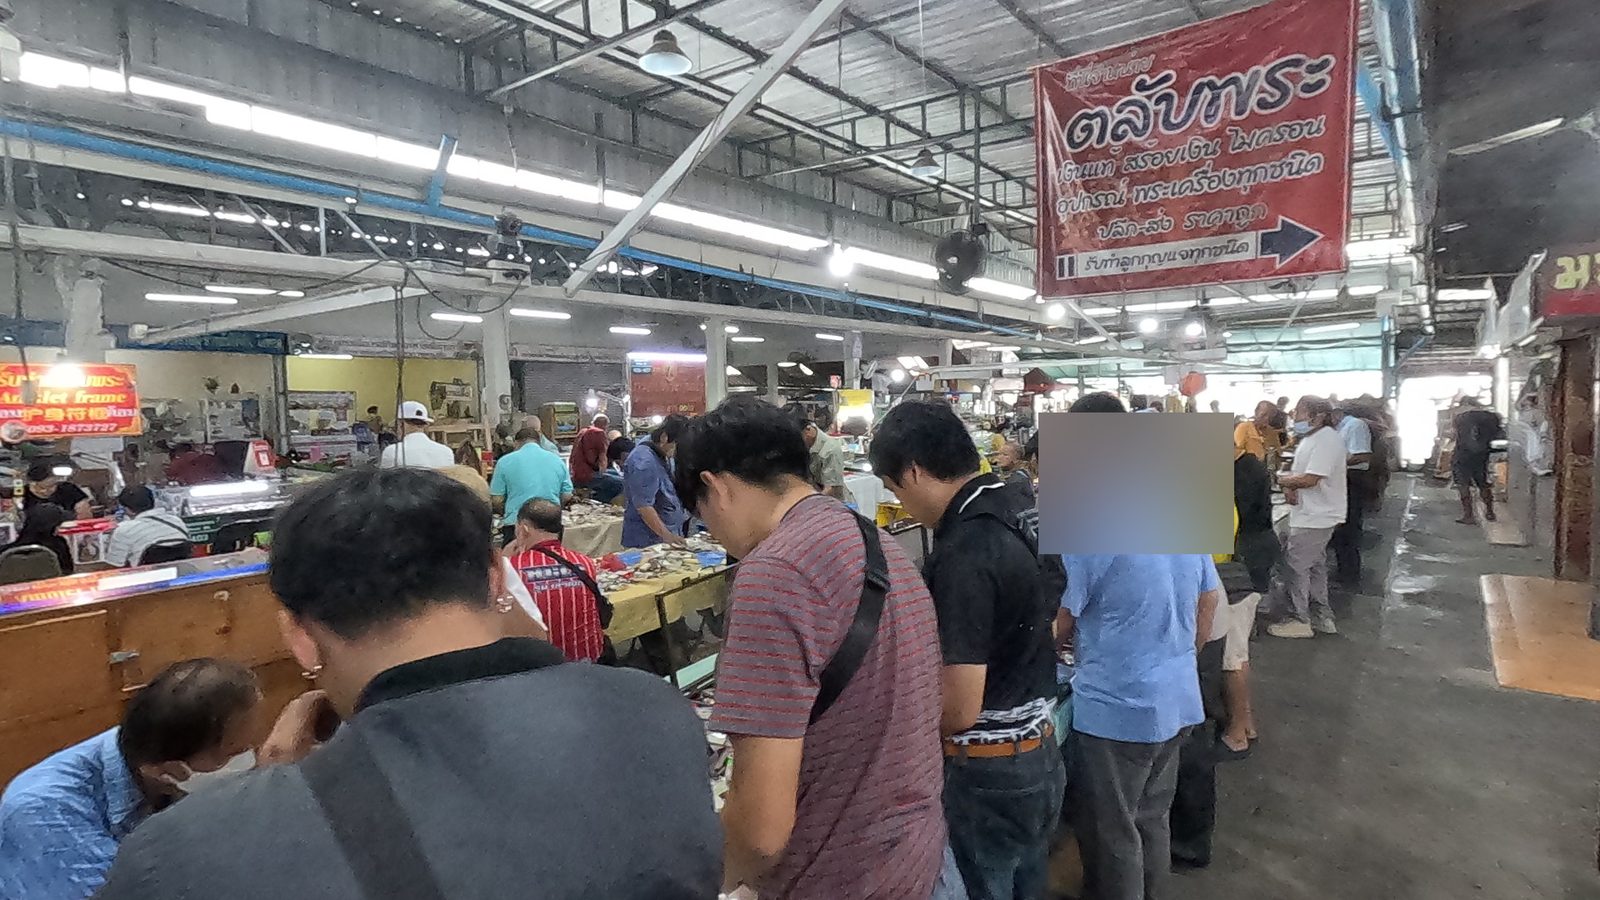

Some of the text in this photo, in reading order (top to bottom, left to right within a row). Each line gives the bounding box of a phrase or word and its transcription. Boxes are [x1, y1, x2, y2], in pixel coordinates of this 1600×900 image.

[1065, 55, 1336, 151] ตลับพระ
[1123, 138, 1221, 173] สร้อยเงิน
[1057, 177, 1129, 223] อุปกรณ์
[1183, 202, 1268, 229] ราคาถูก
